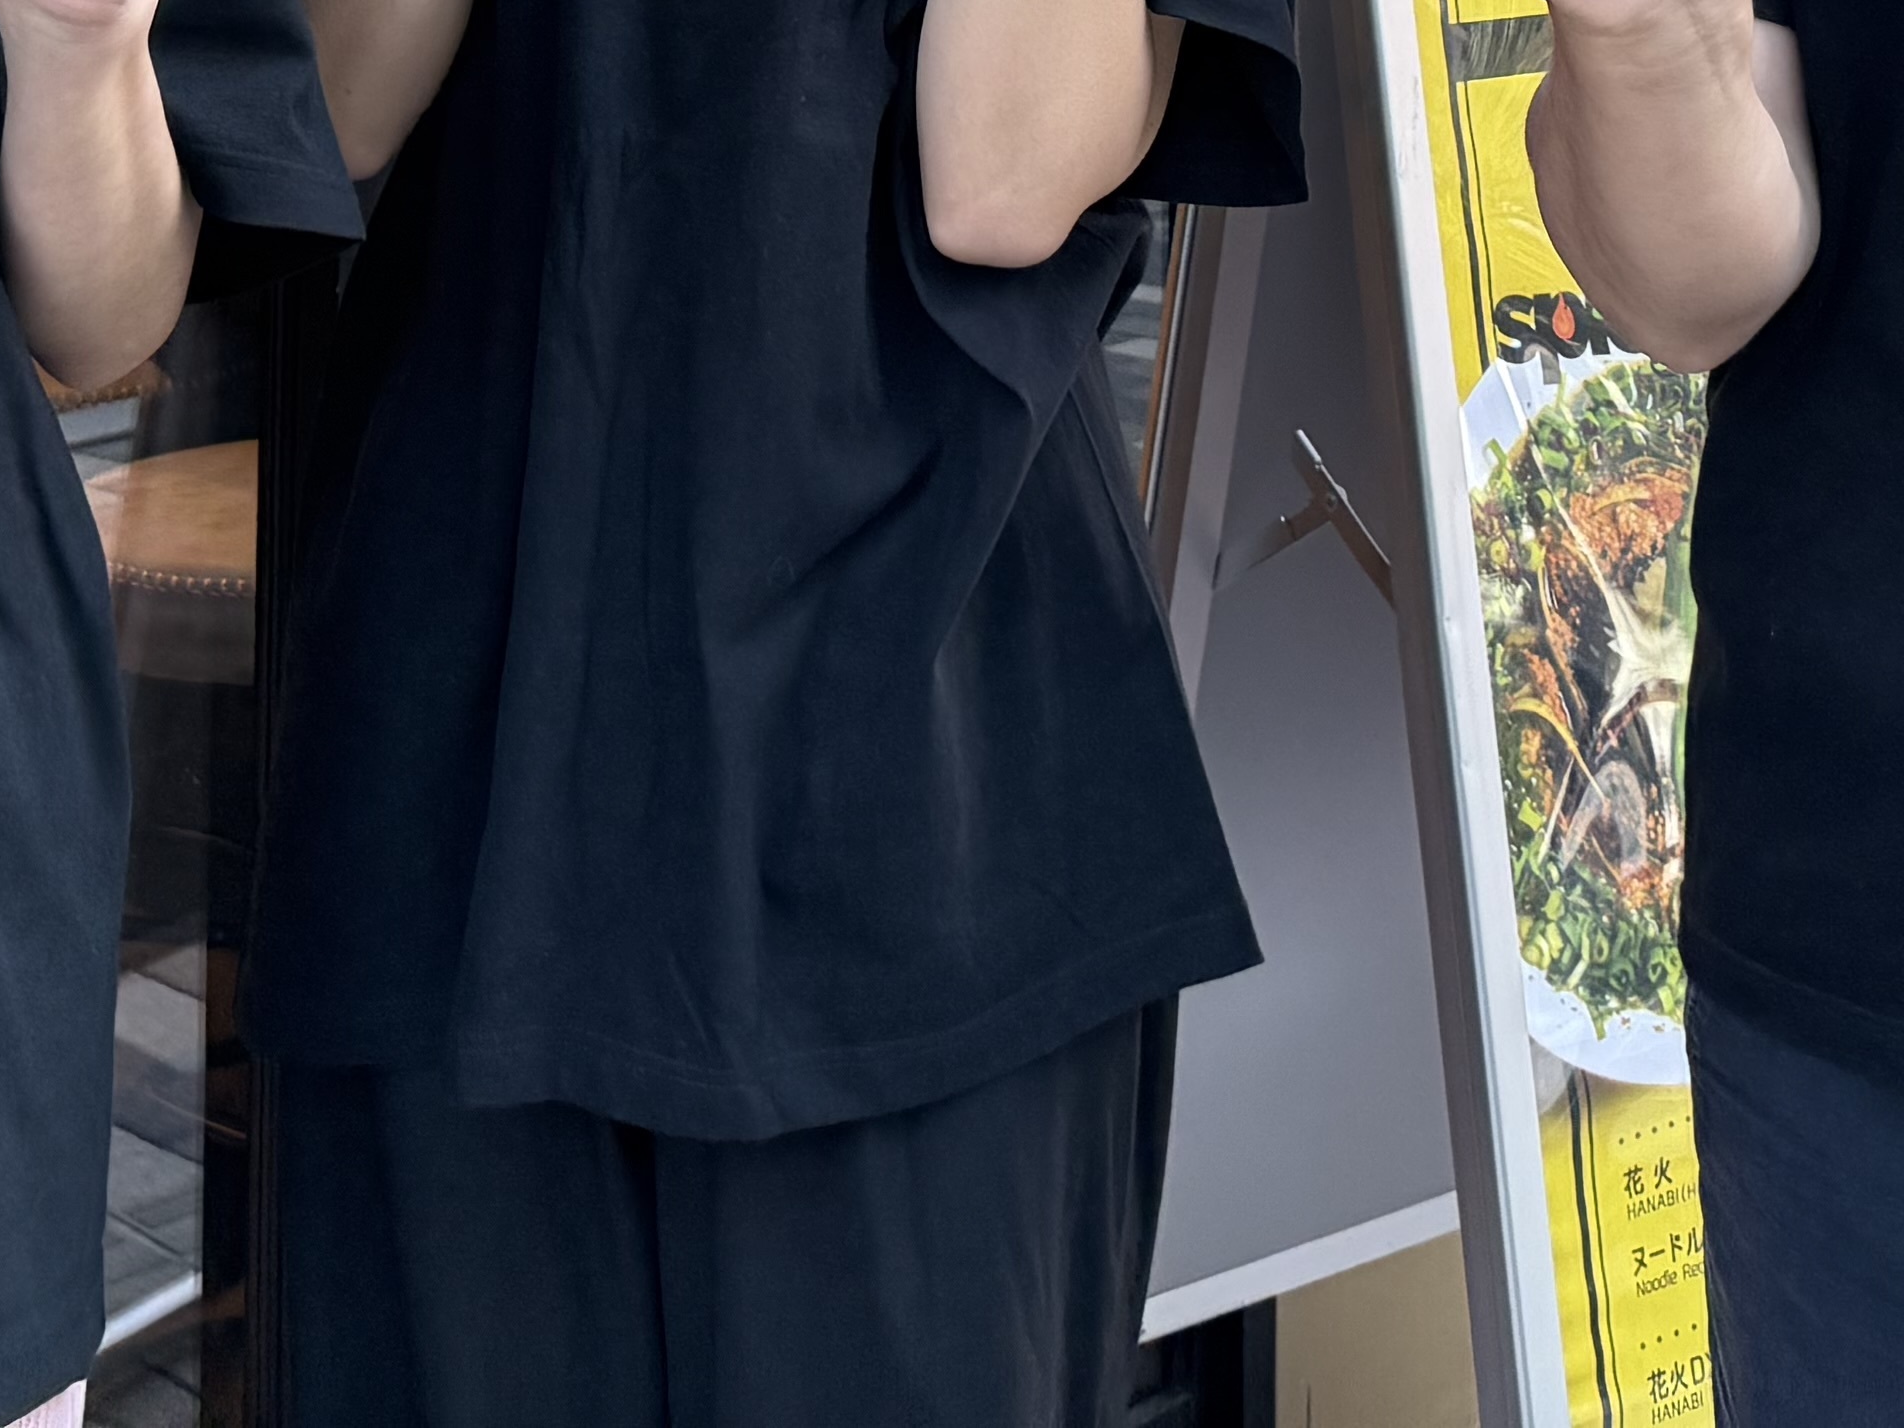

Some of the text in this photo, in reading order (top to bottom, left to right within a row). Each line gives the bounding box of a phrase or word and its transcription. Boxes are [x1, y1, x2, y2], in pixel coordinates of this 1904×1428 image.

[1623, 1156, 1673, 1200] 花火
[1636, 1269, 1678, 1298] Noodle
[1646, 1351, 1710, 1404] 花火D
[1651, 1390, 1704, 1426] HANABI
